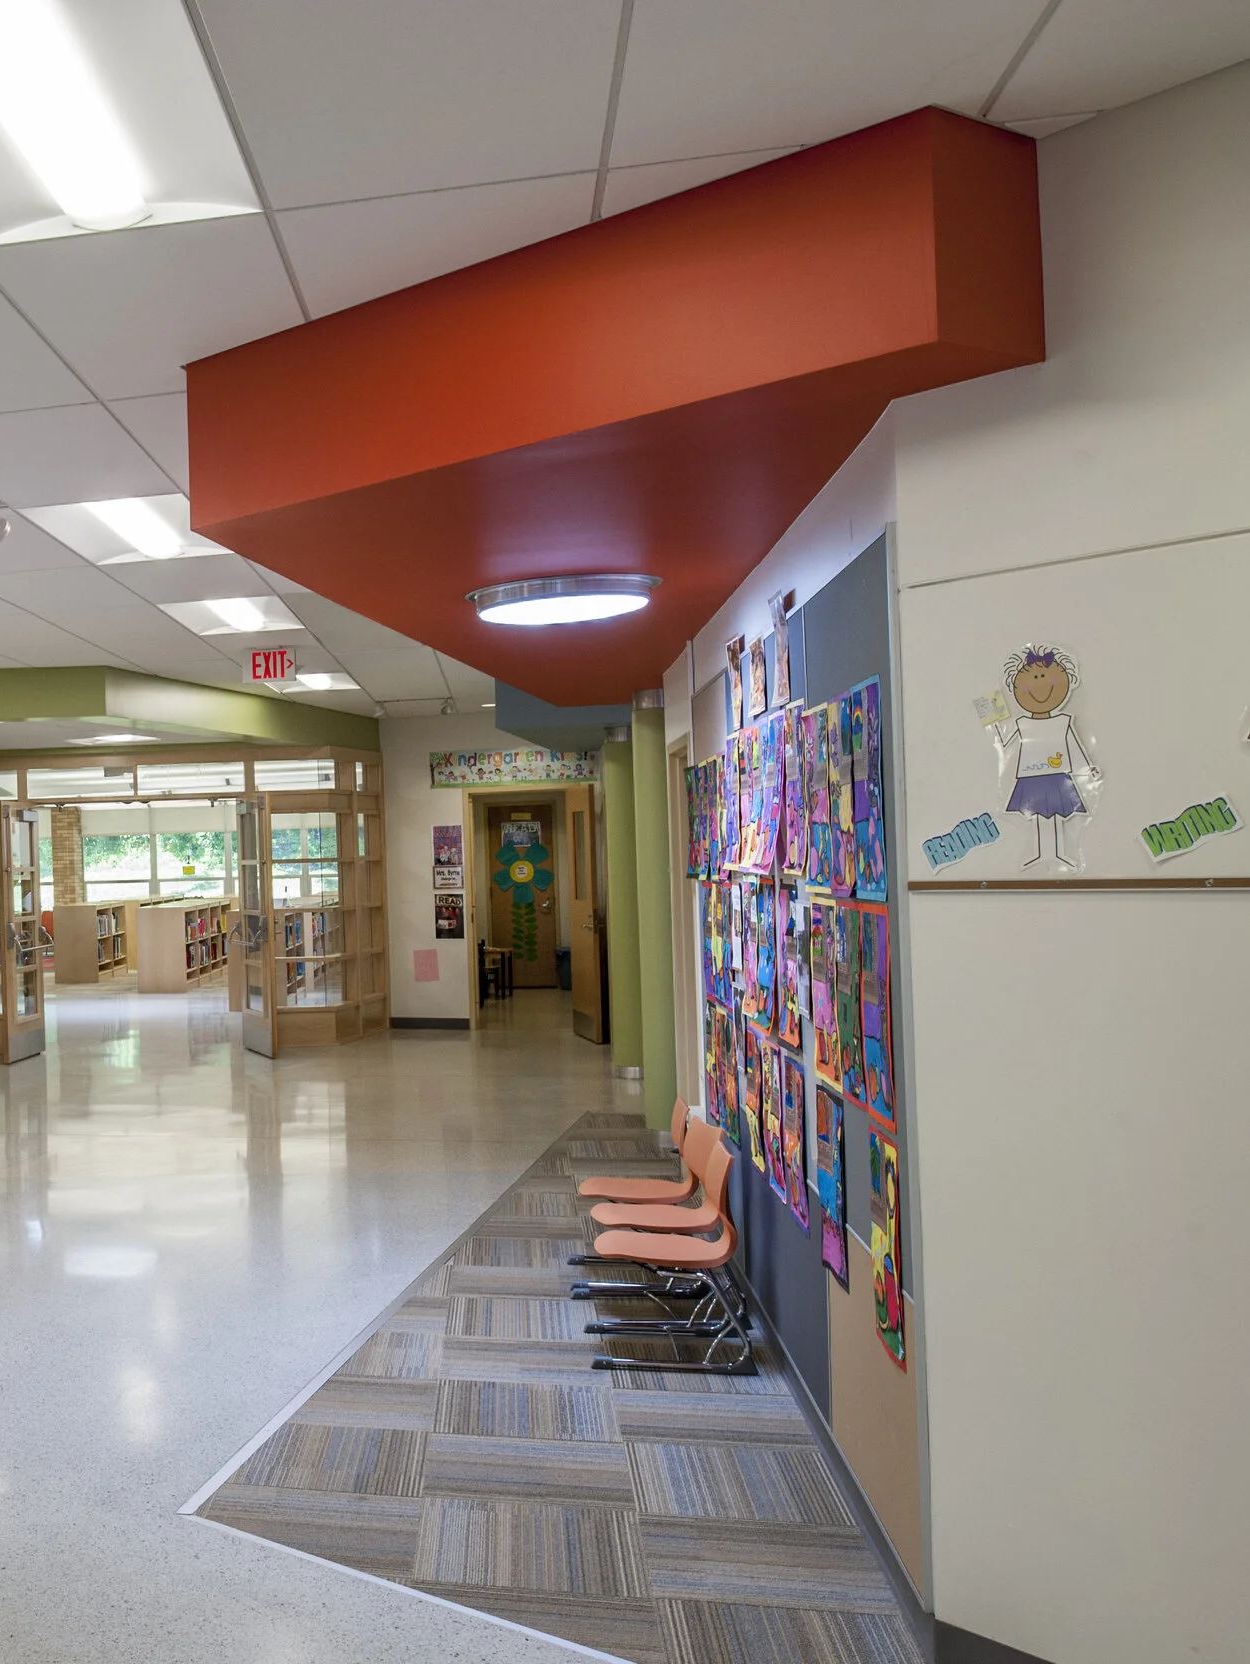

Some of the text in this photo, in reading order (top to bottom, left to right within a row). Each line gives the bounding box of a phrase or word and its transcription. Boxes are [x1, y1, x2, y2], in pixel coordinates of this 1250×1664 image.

[252, 650, 287, 680] EXIT
[444, 749, 544, 768] Kindergarten
[922, 812, 1000, 870] READING
[1141, 797, 1237, 857] WRITING
[438, 896, 461, 906] READ
